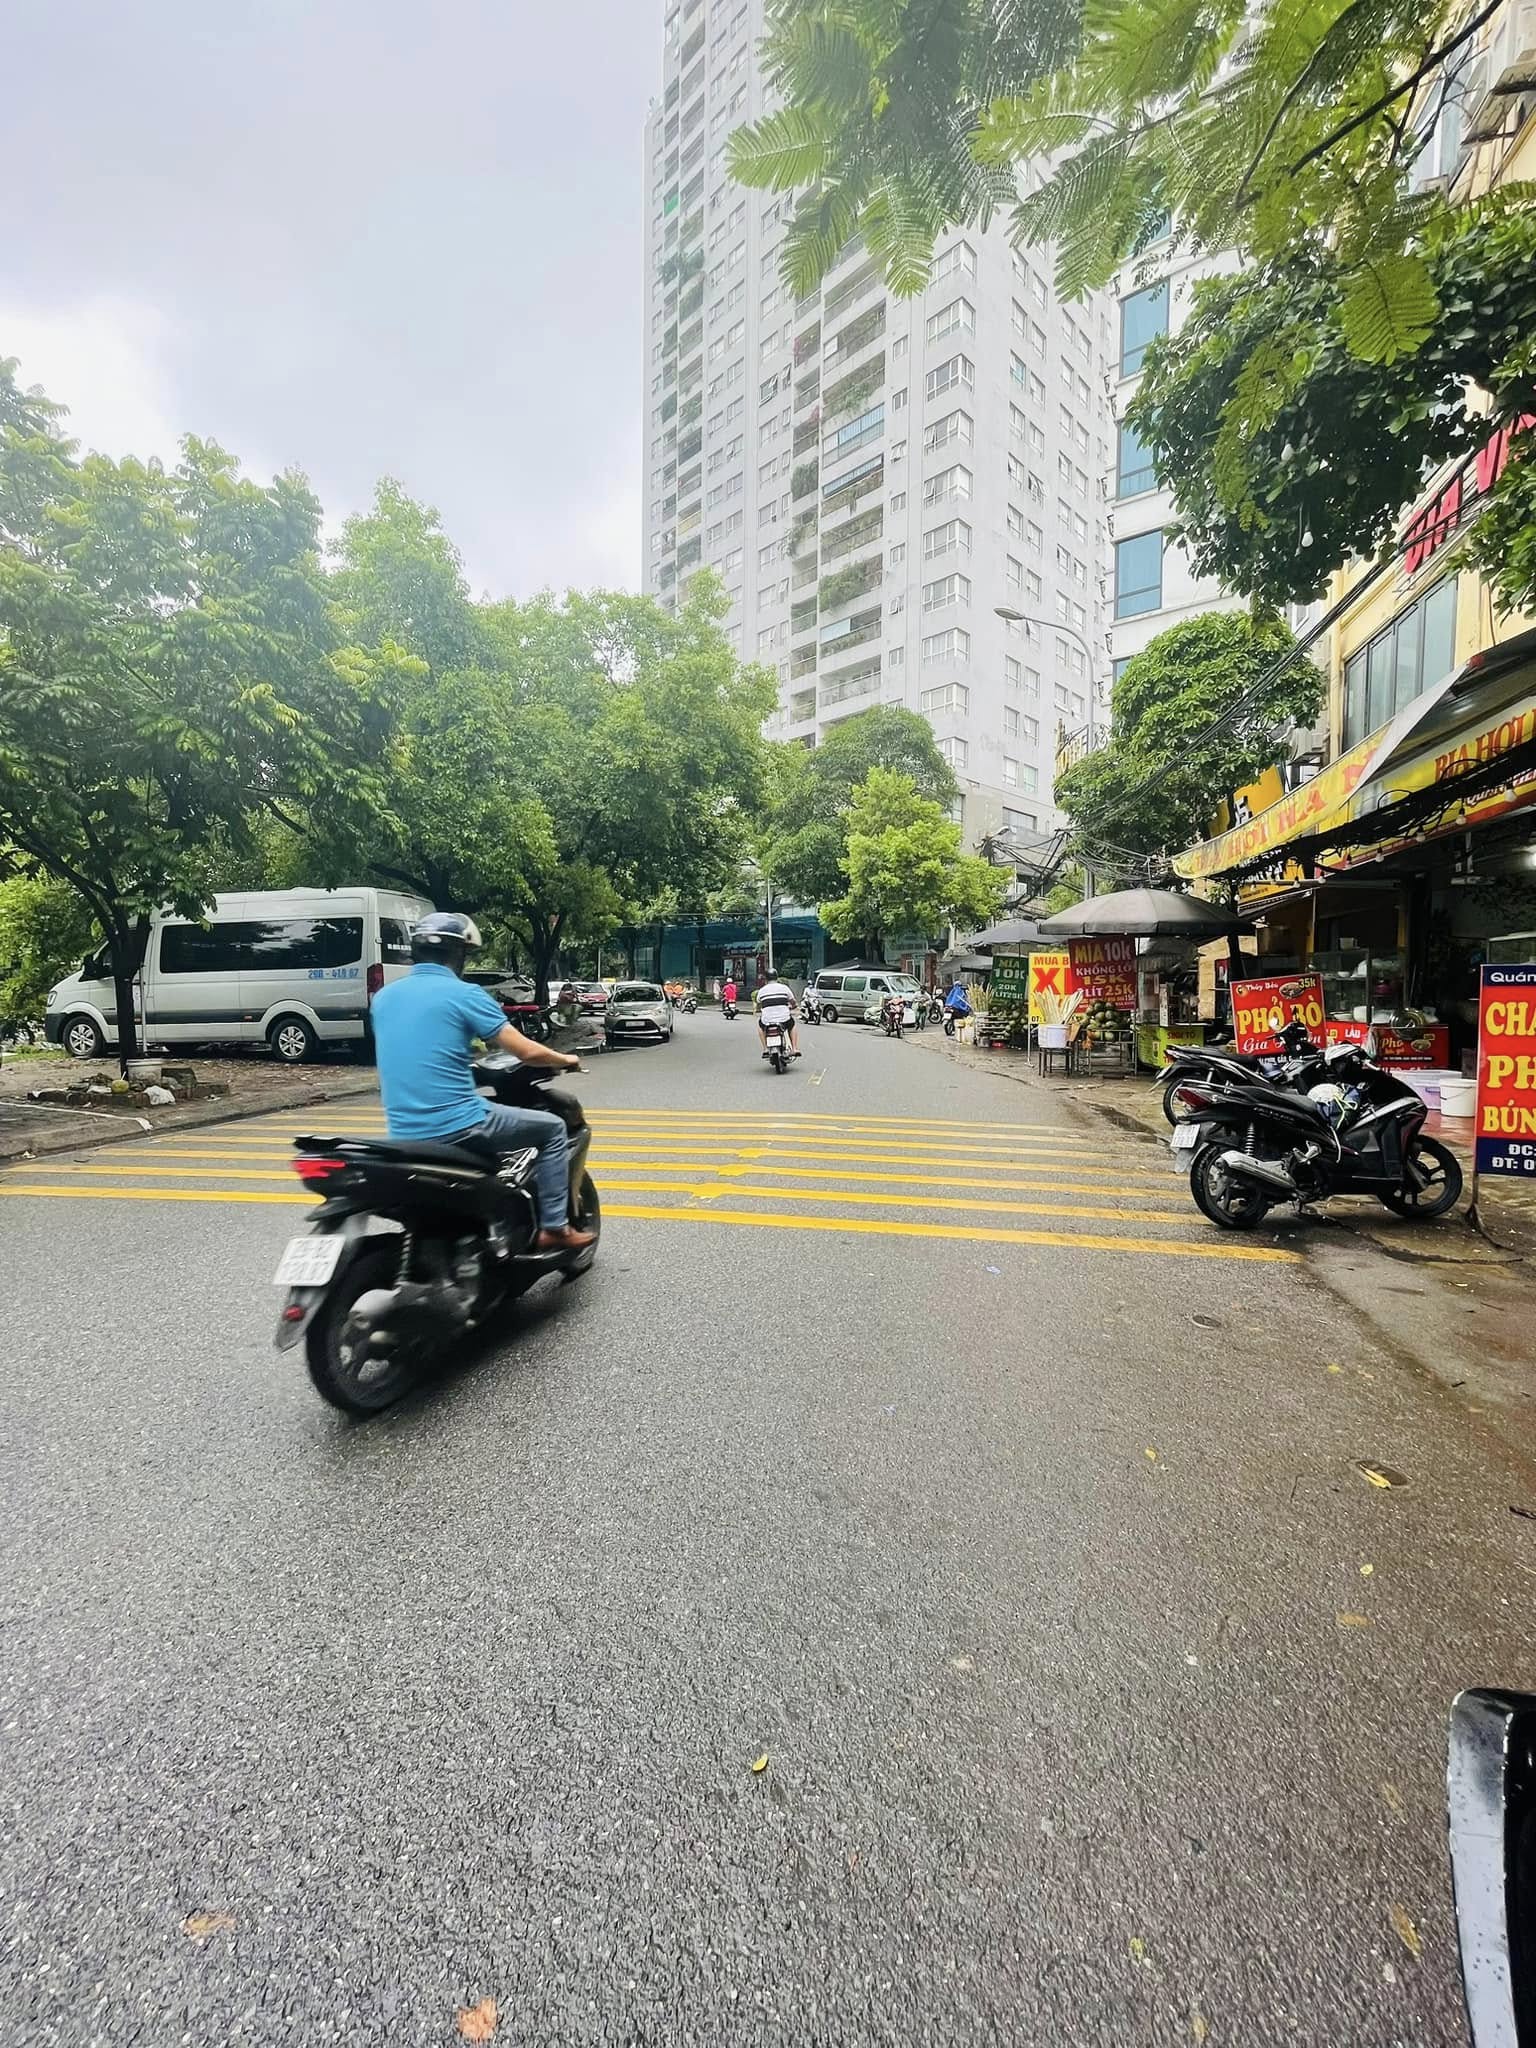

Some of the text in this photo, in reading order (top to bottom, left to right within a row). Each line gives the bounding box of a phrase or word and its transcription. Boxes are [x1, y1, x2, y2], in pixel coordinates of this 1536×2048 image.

[1435, 744, 1469, 781] BIA
[1033, 956, 1058, 966] MUA
[1490, 971, 1536, 983] Quán
[998, 983, 1017, 991] 20K
[1105, 983, 1133, 996] 25K
[1237, 995, 1285, 1034] PHỞ
[1242, 1038, 1268, 1054] Gia
[1492, 1157, 1518, 1169] ĐT:
